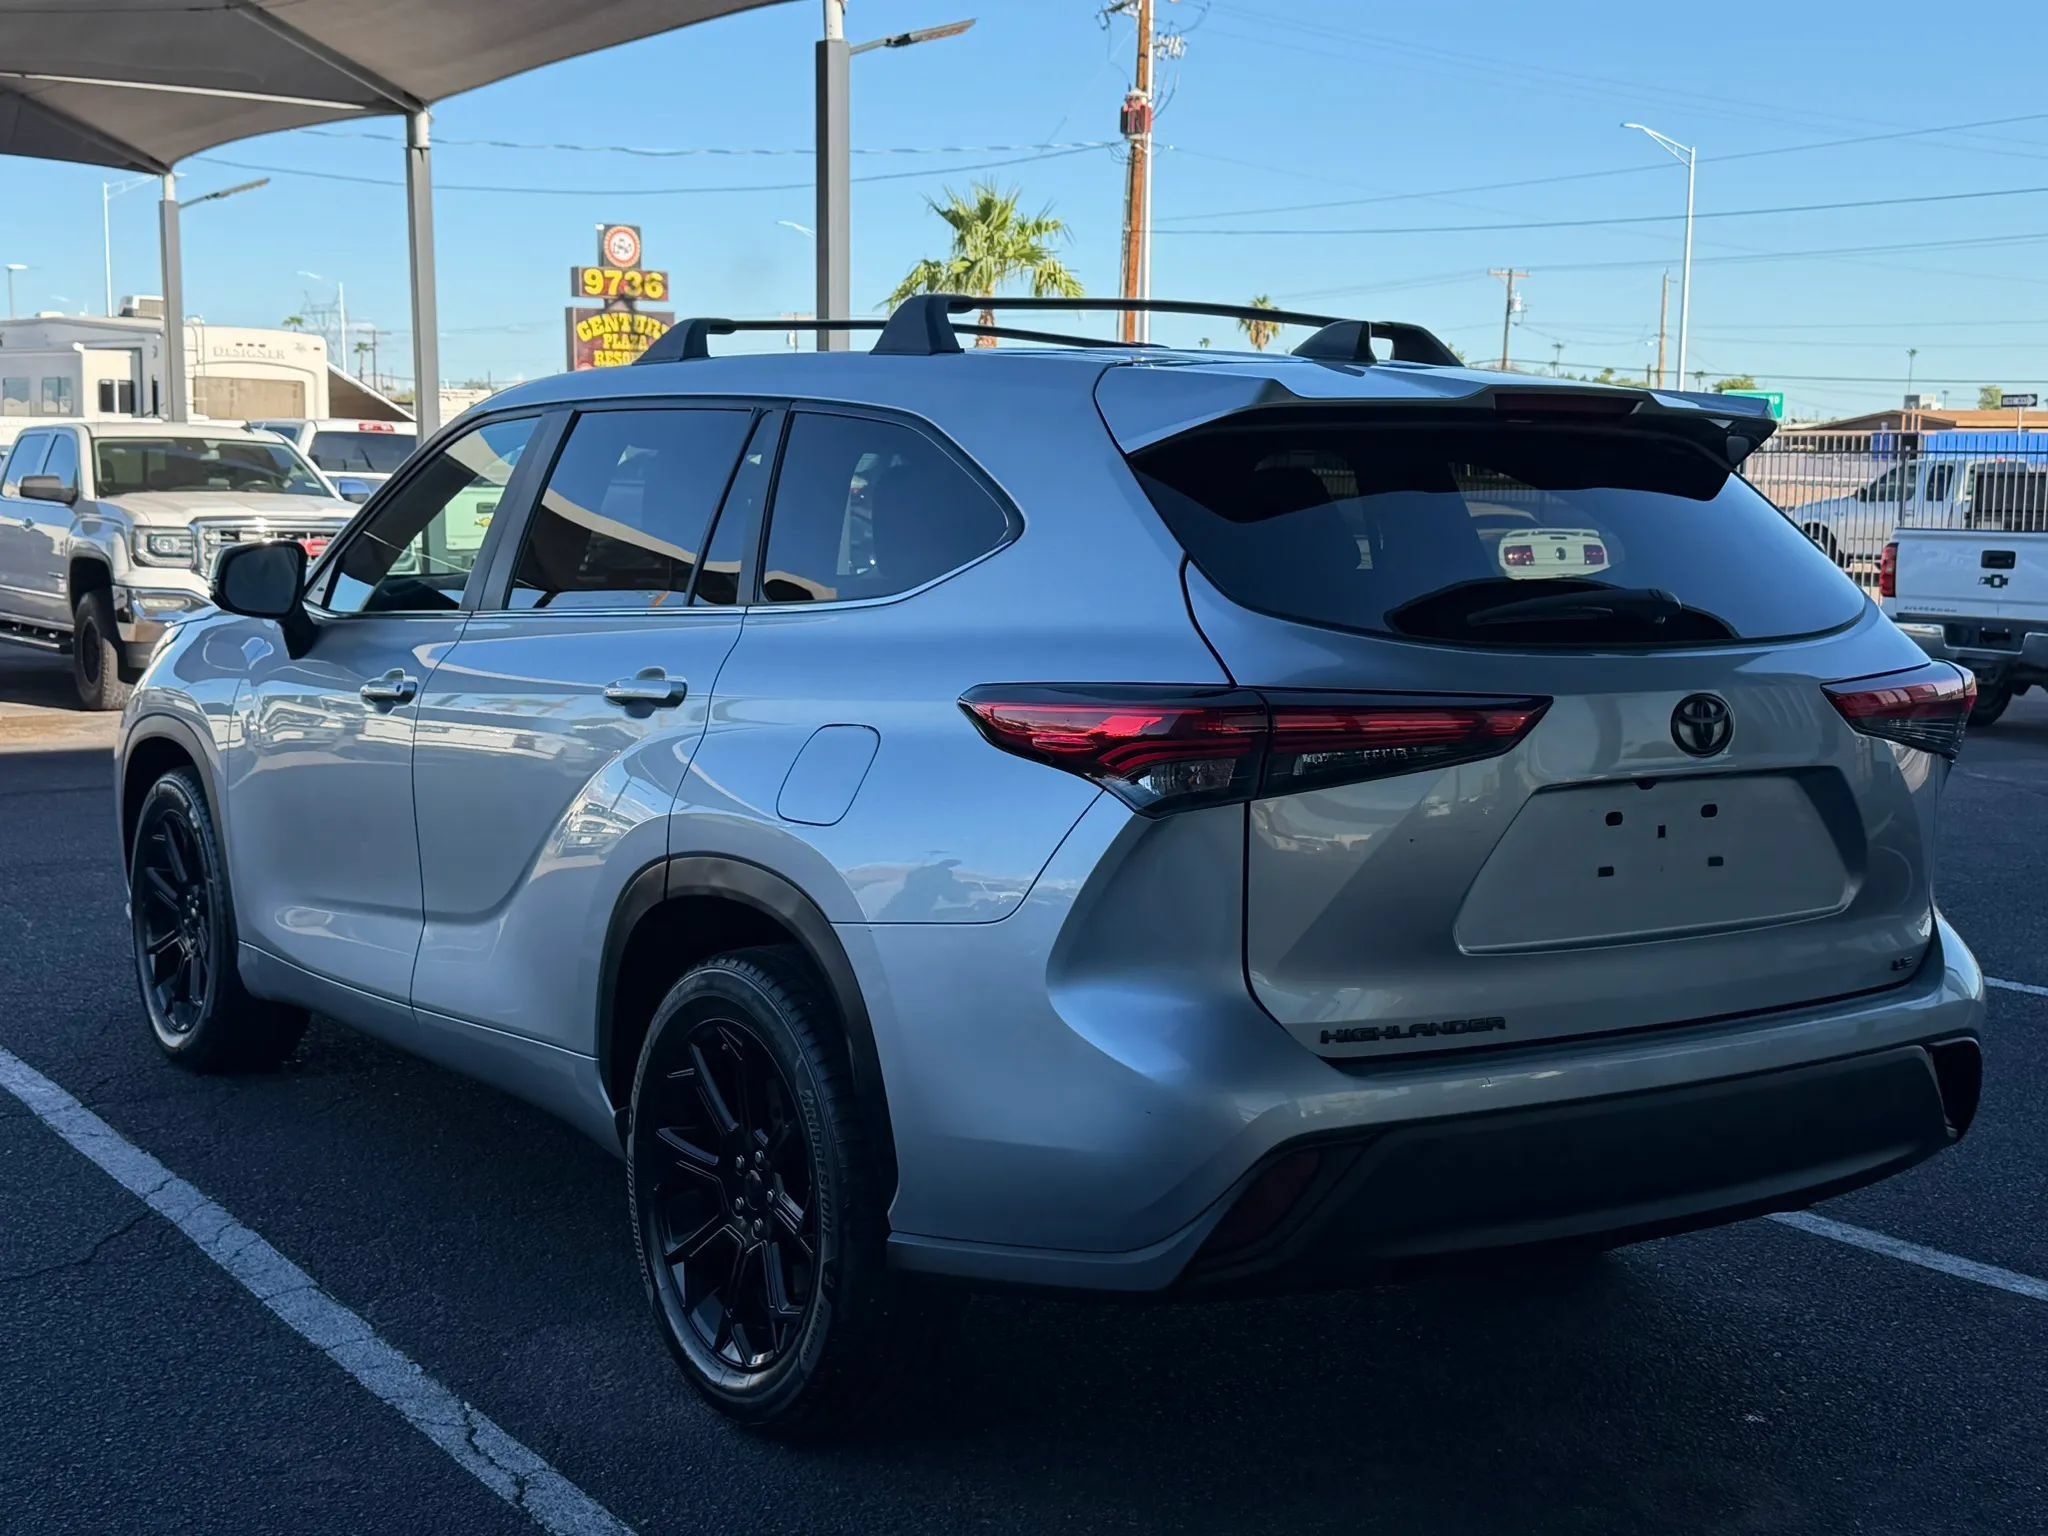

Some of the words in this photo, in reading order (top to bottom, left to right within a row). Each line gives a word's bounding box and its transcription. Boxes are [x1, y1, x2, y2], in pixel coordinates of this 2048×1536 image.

[583, 268, 664, 298] 9736
[213, 346, 285, 359] DESIGNER
[603, 333, 648, 350] PLAZA
[1320, 1016, 1506, 1044] HIGHLANDER
[802, 1088, 831, 1240] BRIDGESTONE
